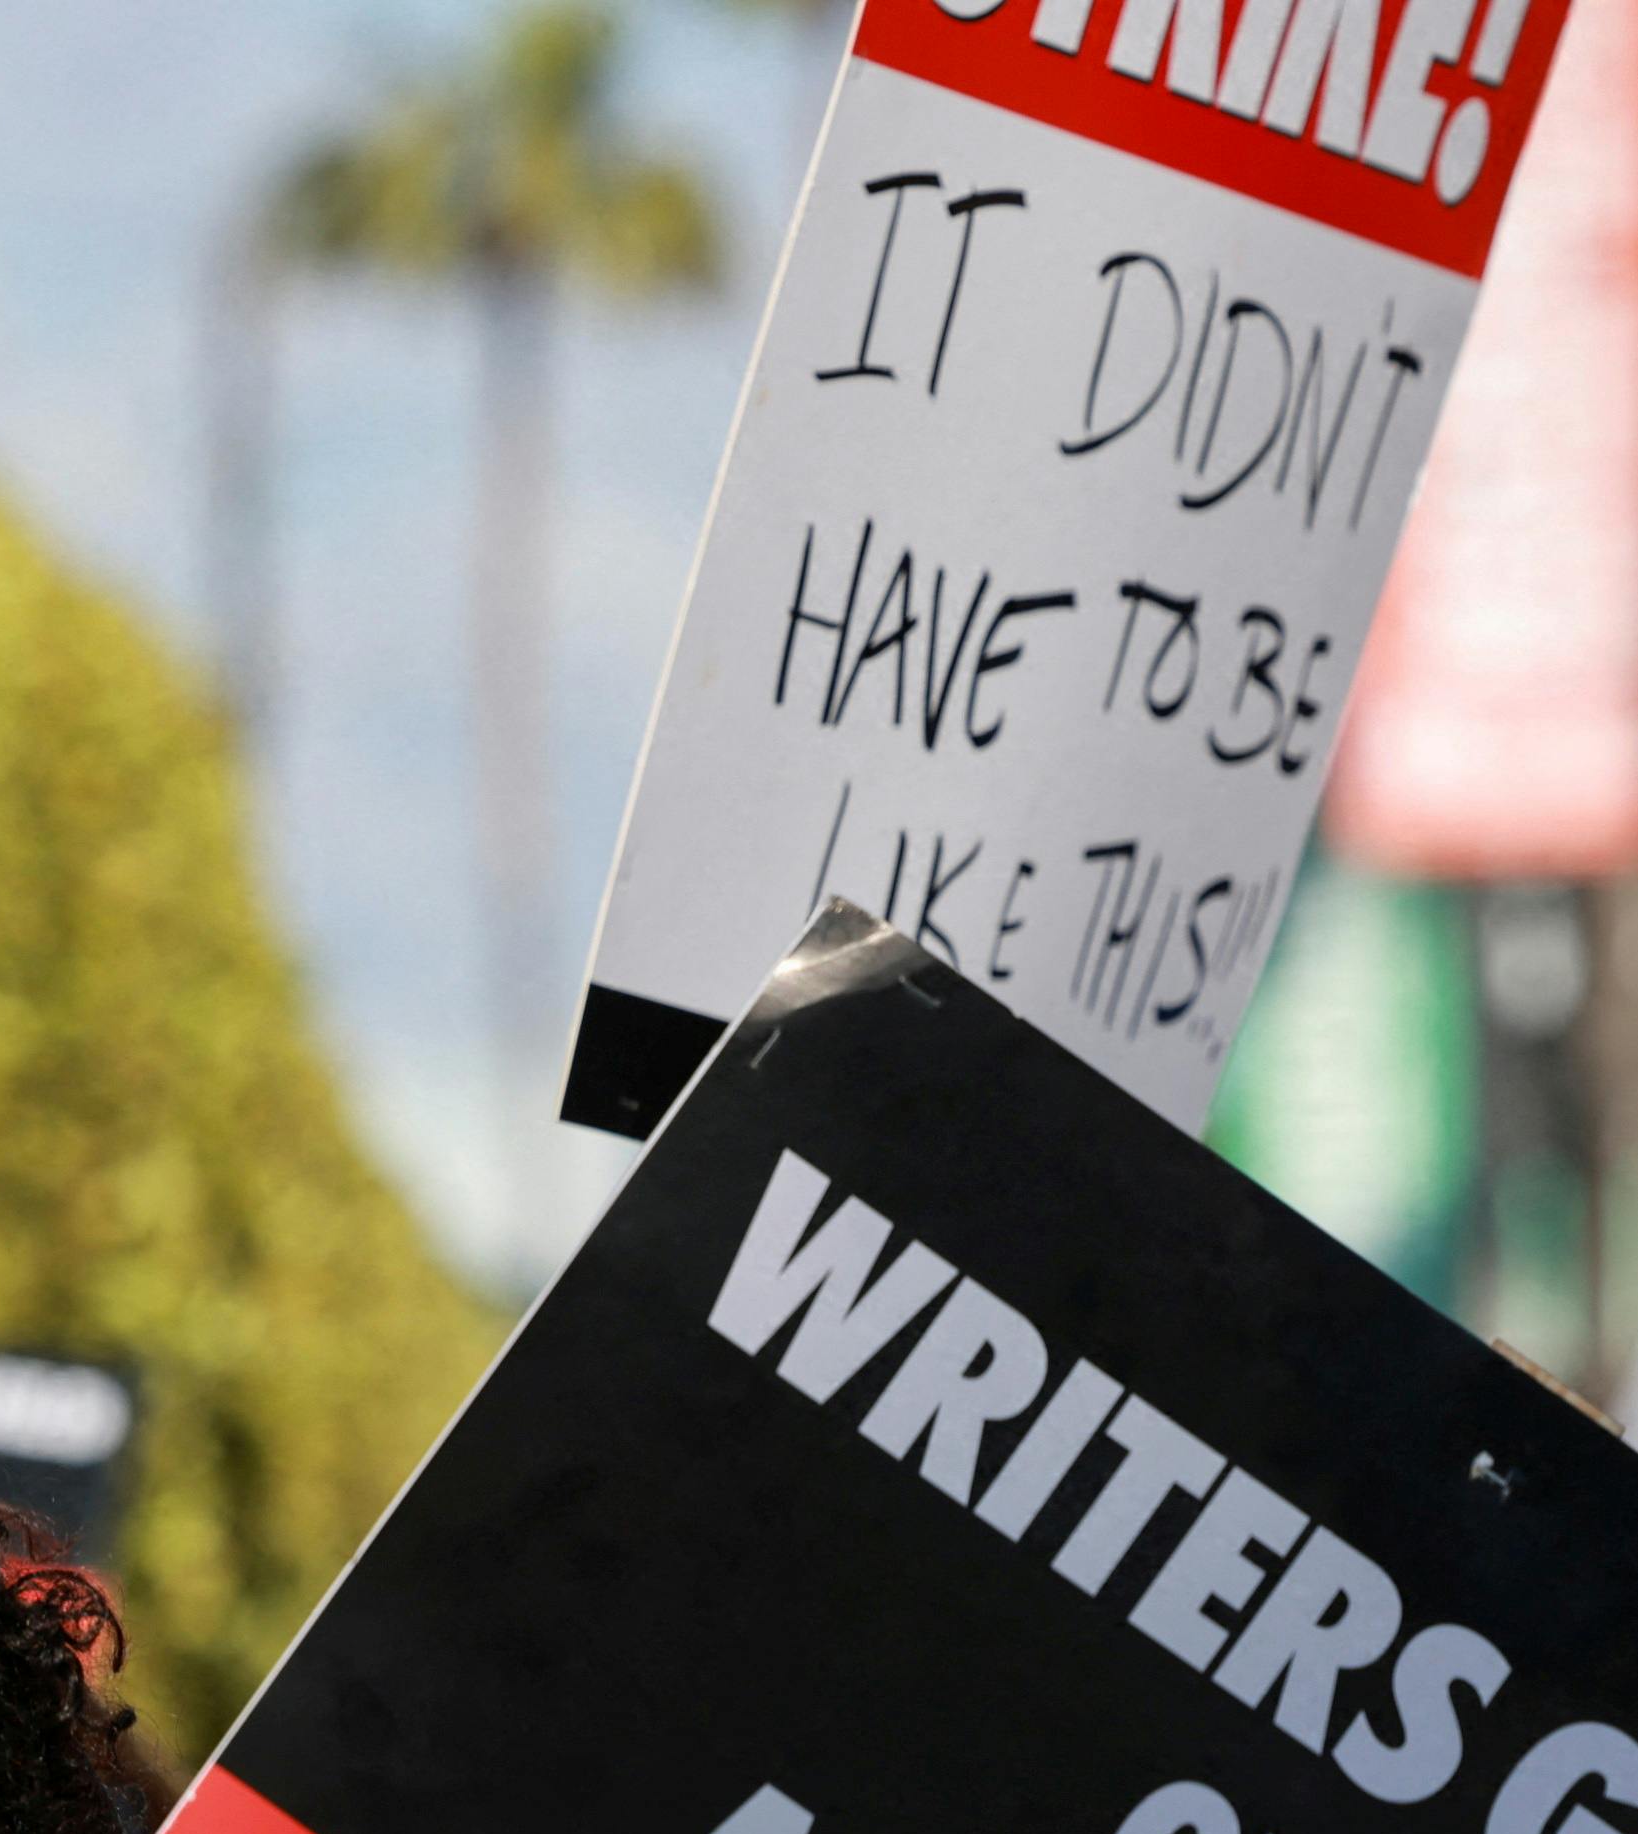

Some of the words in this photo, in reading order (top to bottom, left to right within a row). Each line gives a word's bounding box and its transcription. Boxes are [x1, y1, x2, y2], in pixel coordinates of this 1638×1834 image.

[814, 171, 1028, 396] IT
[1057, 251, 1422, 533] DIDN'T
[773, 517, 1075, 750] HAVE
[1103, 579, 1200, 720] TO
[1206, 607, 1333, 776] BE
[706, 1147, 1513, 1804] WRITERS
